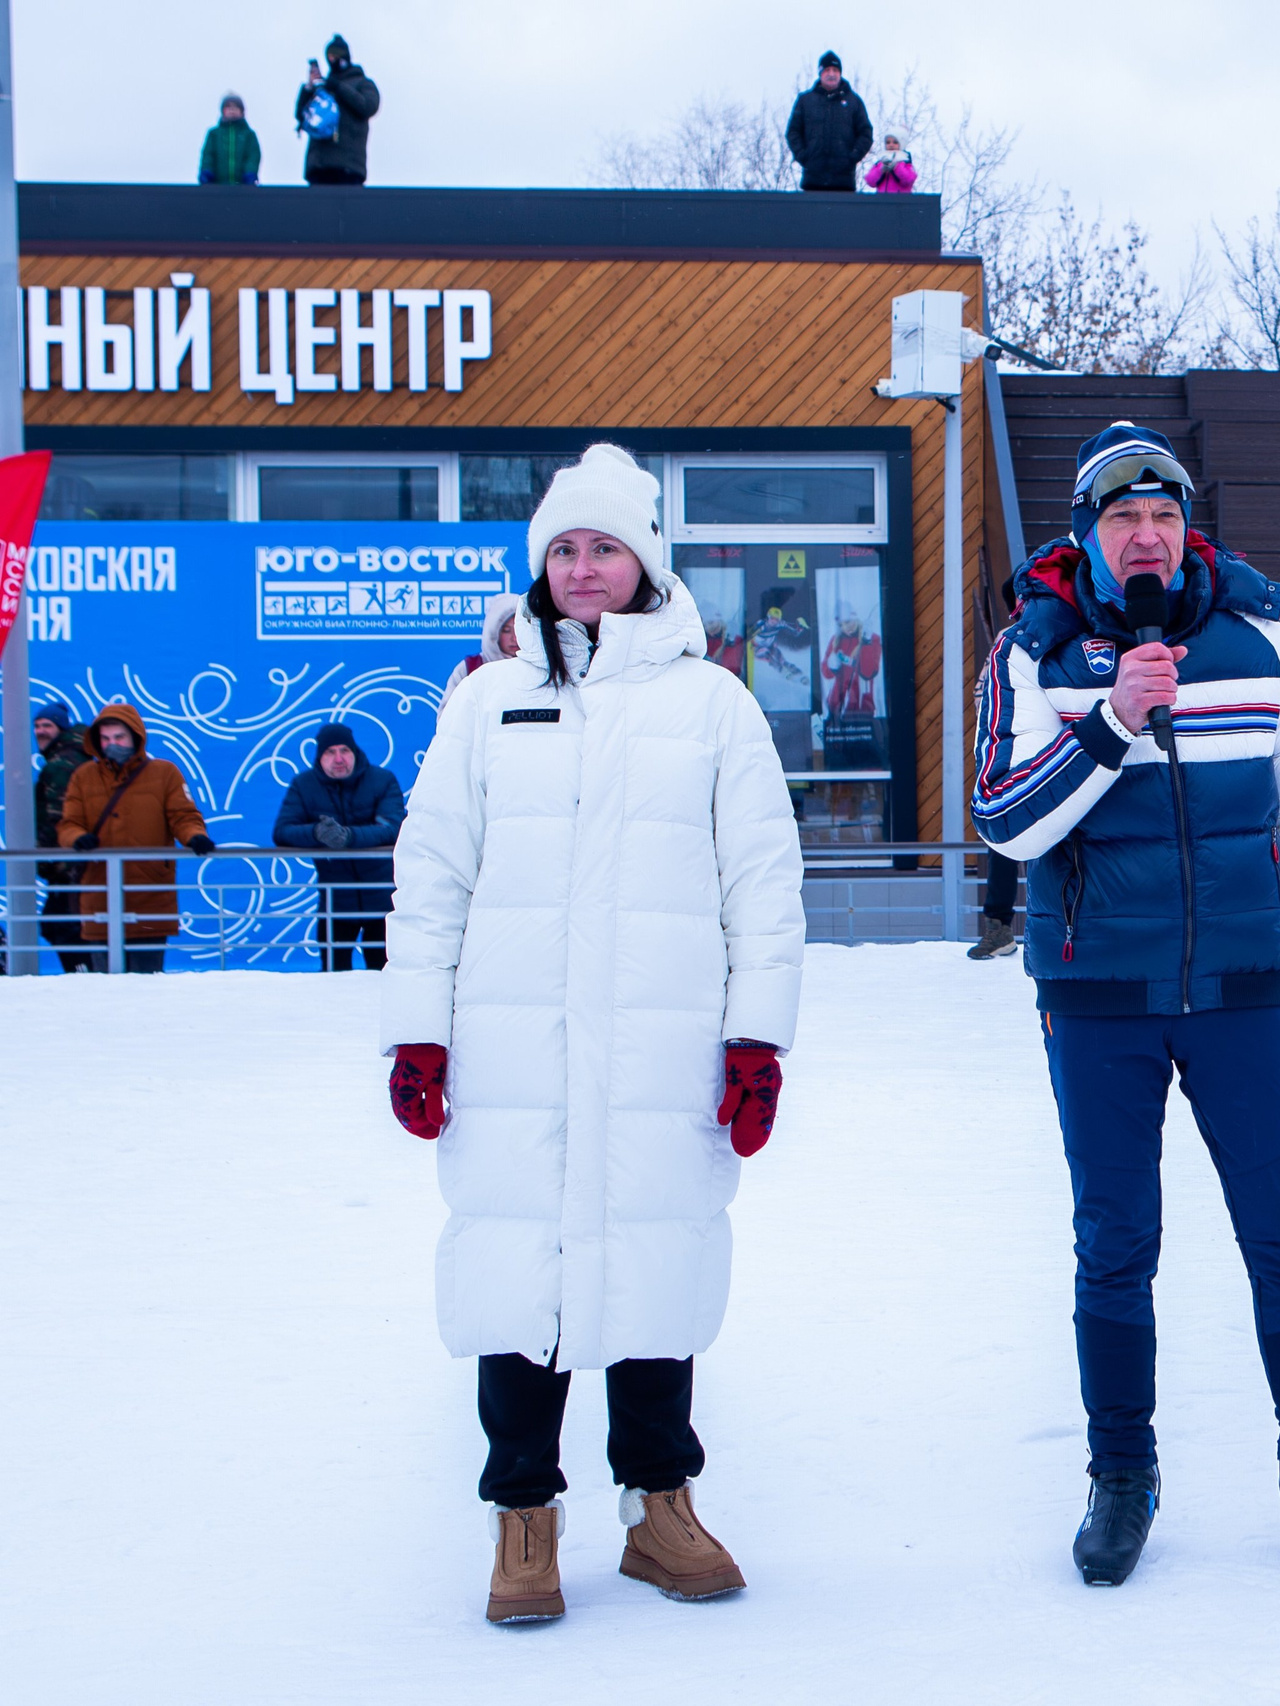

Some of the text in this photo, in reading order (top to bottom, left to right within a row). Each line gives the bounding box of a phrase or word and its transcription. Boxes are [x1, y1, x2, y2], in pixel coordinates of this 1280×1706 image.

[17, 272, 492, 404] НЫЙ ЦЕНТР
[25, 546, 177, 591] КОВСКАЯ
[256, 546, 507, 572] ЮГО-ВОСТОК
[26, 596, 72, 641] НЯ
[442, 619, 484, 629] КОМПЛЕ
[508, 711, 554, 721] PELLIOT
